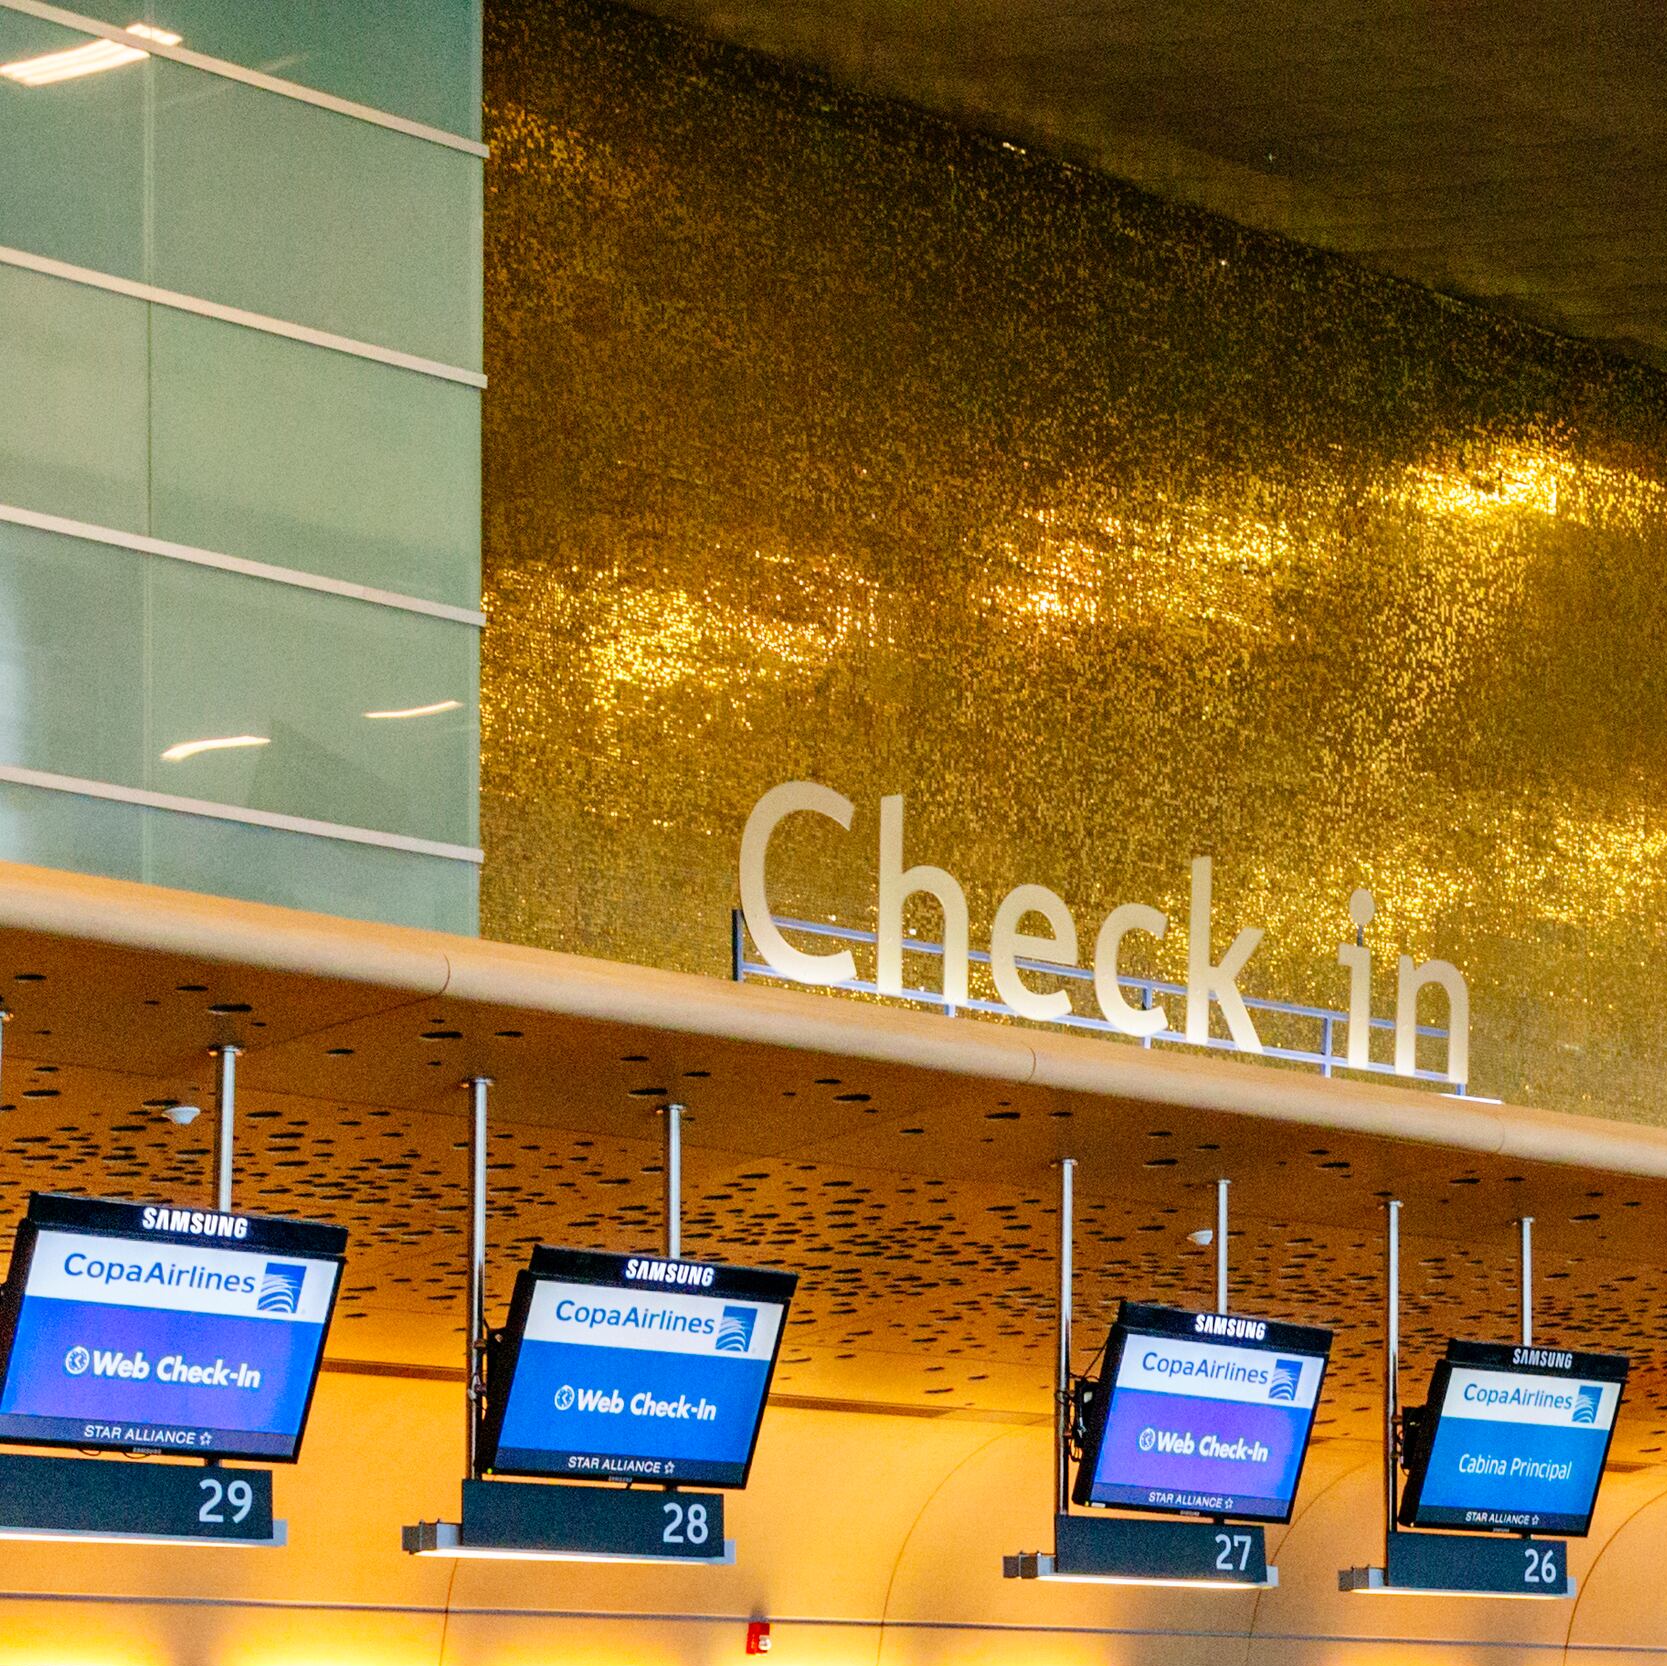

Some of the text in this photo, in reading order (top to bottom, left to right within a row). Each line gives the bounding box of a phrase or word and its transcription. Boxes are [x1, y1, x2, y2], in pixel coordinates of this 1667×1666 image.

[740, 781, 1468, 1084] Check in
[142, 1206, 248, 1239] SAMSUNG
[625, 1258, 714, 1288] SAMSUNG
[1195, 1314, 1266, 1341] SAMSUNG
[93, 1349, 261, 1390] Web Check-In
[1512, 1347, 1572, 1369] SAMSUNG
[577, 1388, 717, 1423] Web Check-In
[84, 1424, 196, 1444] STAR ALLIANCE
[1157, 1431, 1268, 1463] Web Check-In
[568, 1456, 661, 1474] STAR ALLIANCE
[1458, 1453, 1572, 1483] Cabina Principal
[199, 1478, 253, 1524] 29
[1148, 1491, 1224, 1510] STAR ALLIANCE
[662, 1502, 709, 1544] 28
[1465, 1511, 1531, 1527] STAR ALLIANCE
[1214, 1535, 1252, 1571] 27
[1524, 1548, 1557, 1584] 26
